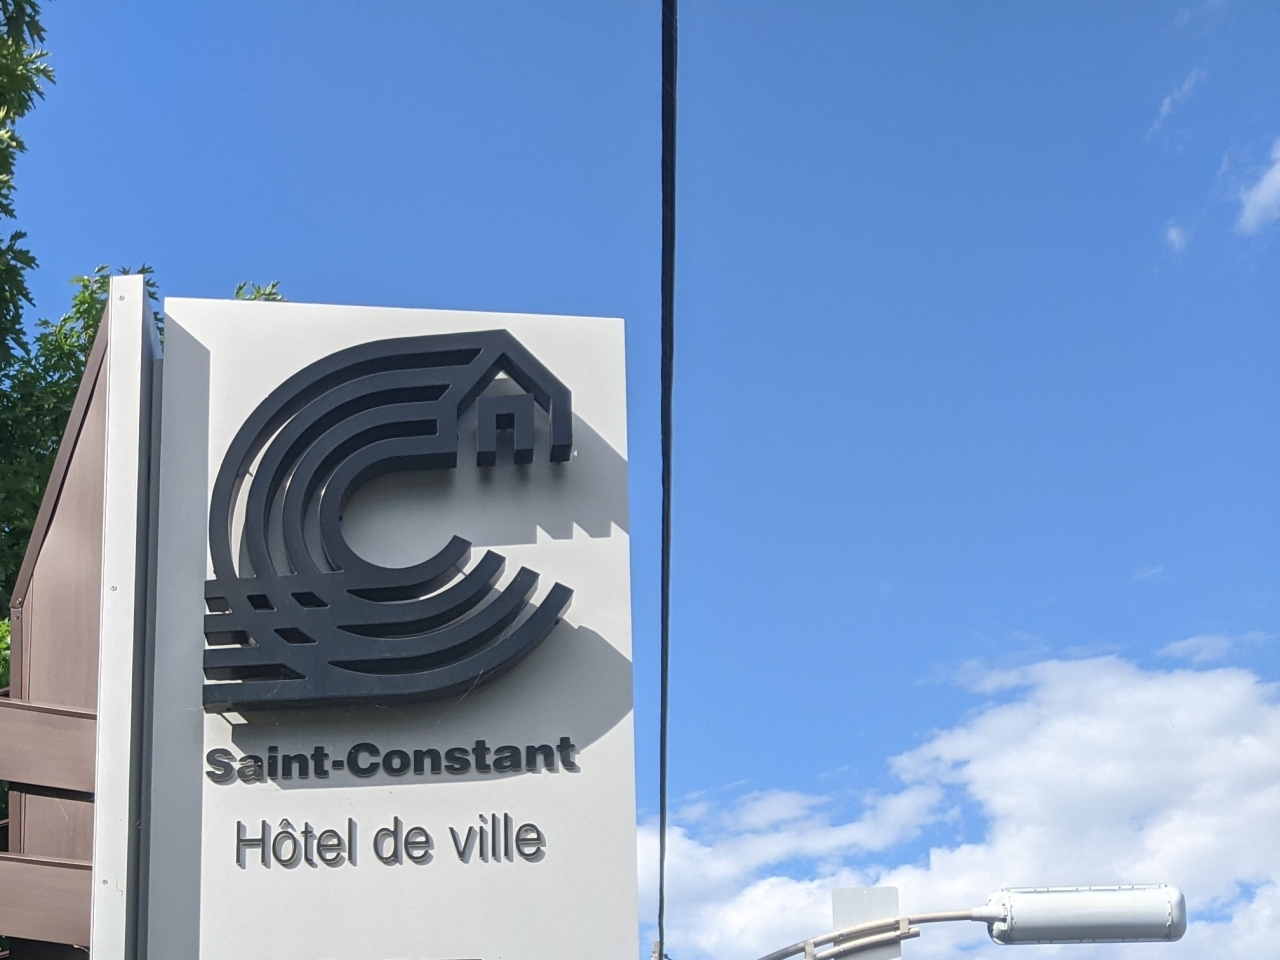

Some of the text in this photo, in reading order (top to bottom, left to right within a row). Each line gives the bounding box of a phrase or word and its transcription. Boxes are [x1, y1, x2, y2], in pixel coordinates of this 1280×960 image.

[205, 735, 578, 782] Saint-Constant
[235, 812, 546, 869] Hôtel de ville
